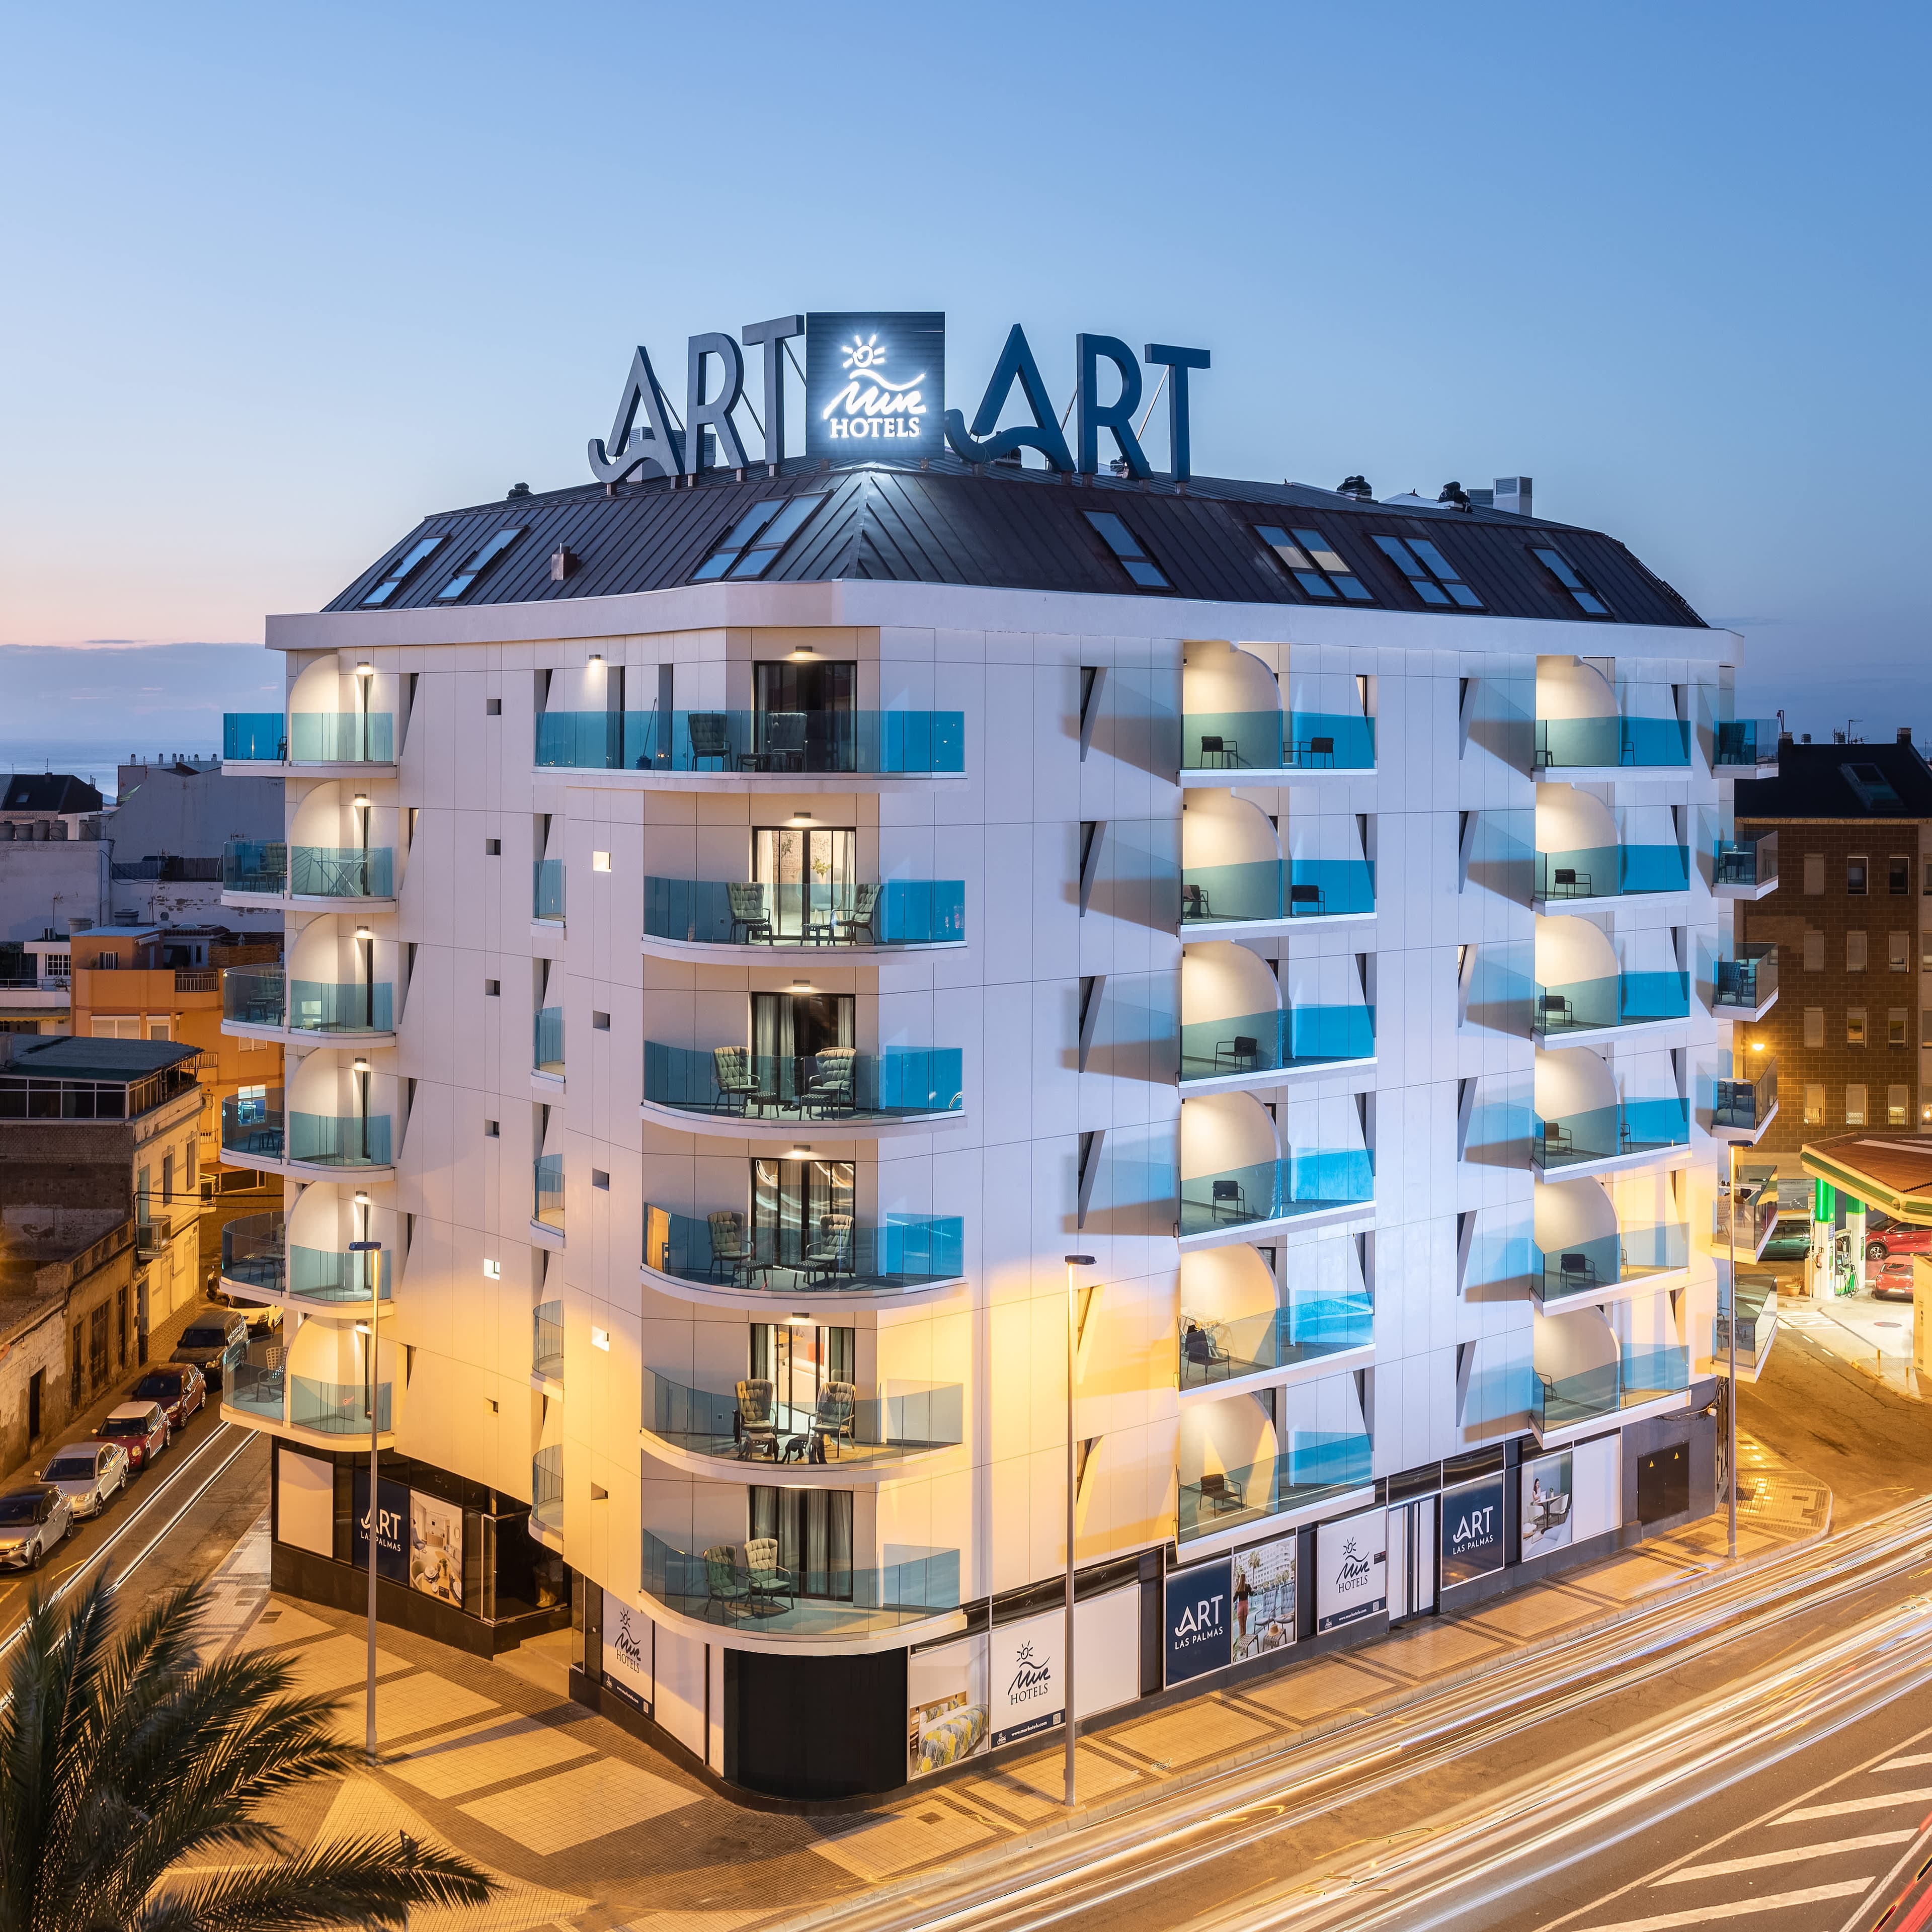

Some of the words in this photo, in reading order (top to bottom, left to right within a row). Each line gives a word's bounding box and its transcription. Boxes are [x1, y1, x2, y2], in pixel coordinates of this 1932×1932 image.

[588, 314, 805, 484] ART
[944, 323, 1211, 483] ART
[830, 417, 920, 438] HOTELS
[1453, 1505, 1493, 1543] ART
[361, 1531, 371, 1541] LA
[1453, 1544, 1465, 1555] LAS
[1468, 1535, 1493, 1550] PALMAS
[1338, 1575, 1368, 1593] HOTELS
[1175, 1594, 1223, 1637] ART
[1175, 1638, 1189, 1650] LAS
[1192, 1626, 1223, 1644] PALMAS
[616, 1649, 639, 1673] HOTELS
[1010, 1682, 1048, 1705] HOTELS
[1011, 1721, 1047, 1736] www.murhotels.com
